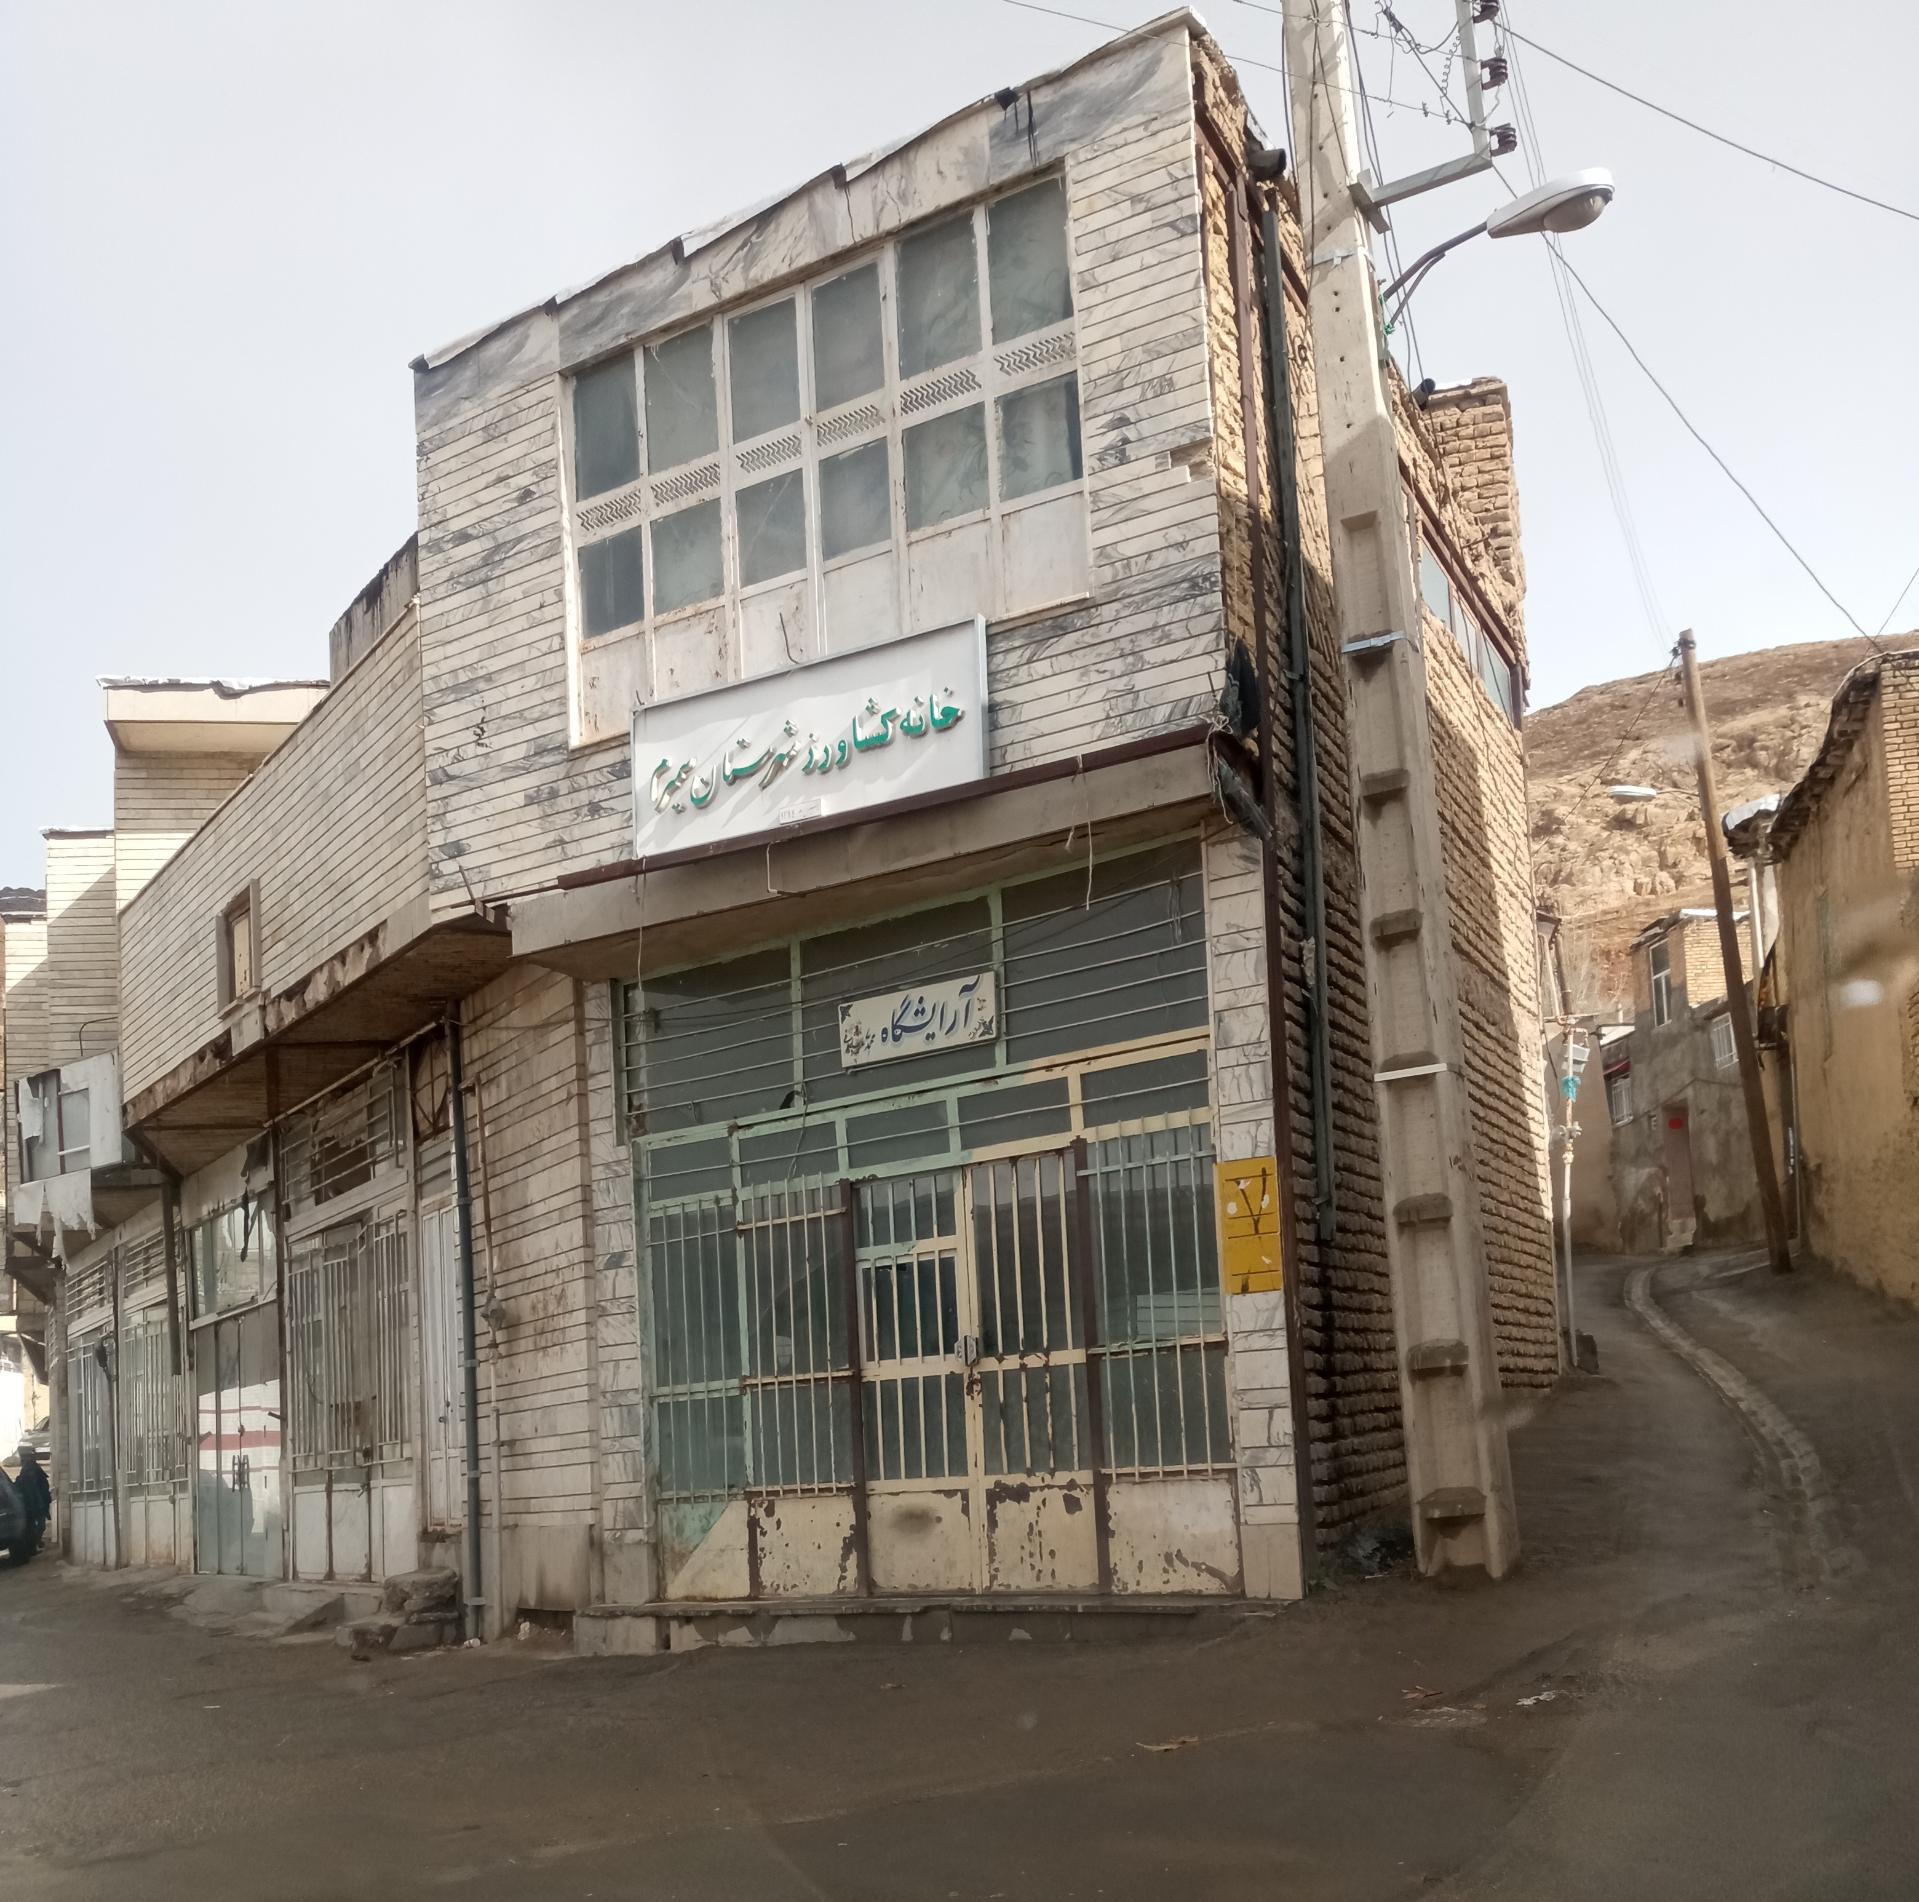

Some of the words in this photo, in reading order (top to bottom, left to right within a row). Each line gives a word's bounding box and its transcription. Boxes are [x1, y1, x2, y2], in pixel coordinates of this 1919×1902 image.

[801, 697, 903, 776] کشاورز
[899, 686, 962, 737] خانه
[690, 719, 800, 808] شهرستان
[880, 974, 980, 1042] آرایشگاه
